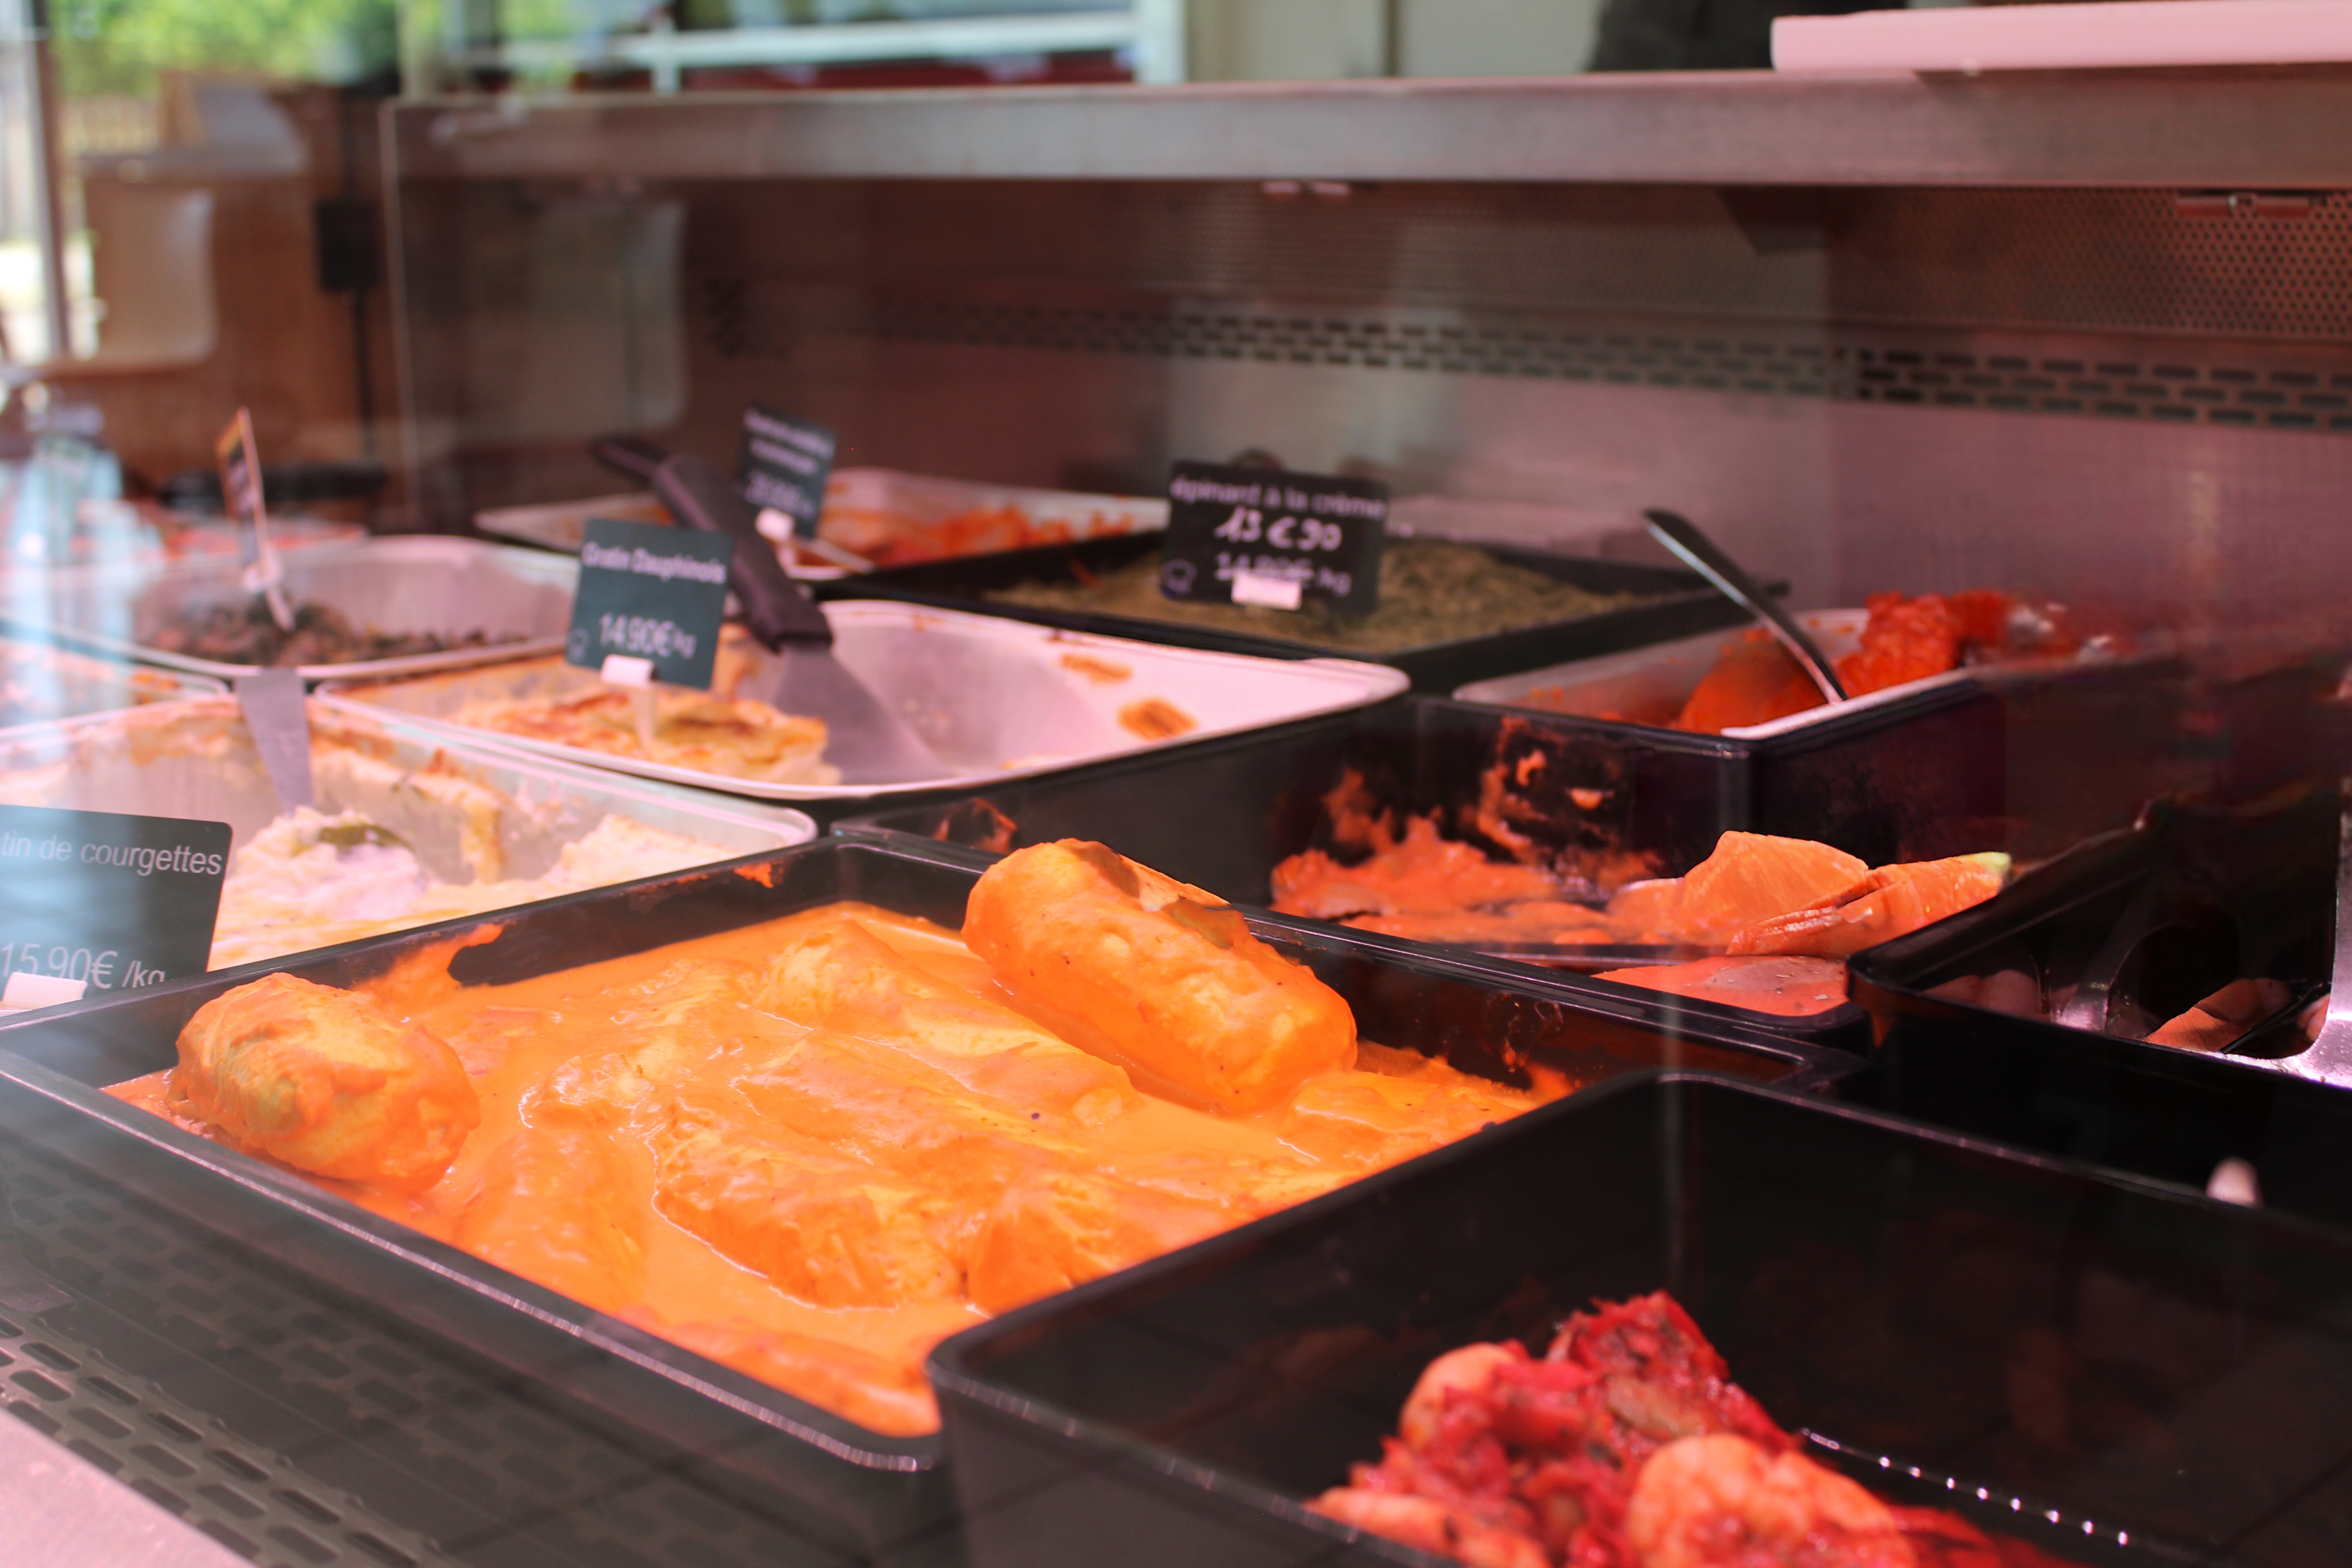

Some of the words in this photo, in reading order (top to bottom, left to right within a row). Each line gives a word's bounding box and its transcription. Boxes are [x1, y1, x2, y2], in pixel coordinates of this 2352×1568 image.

[1286, 487, 1308, 512] la
[582, 541, 631, 571] Gratin
[39, 833, 72, 861] de
[80, 843, 222, 876] courgettes
